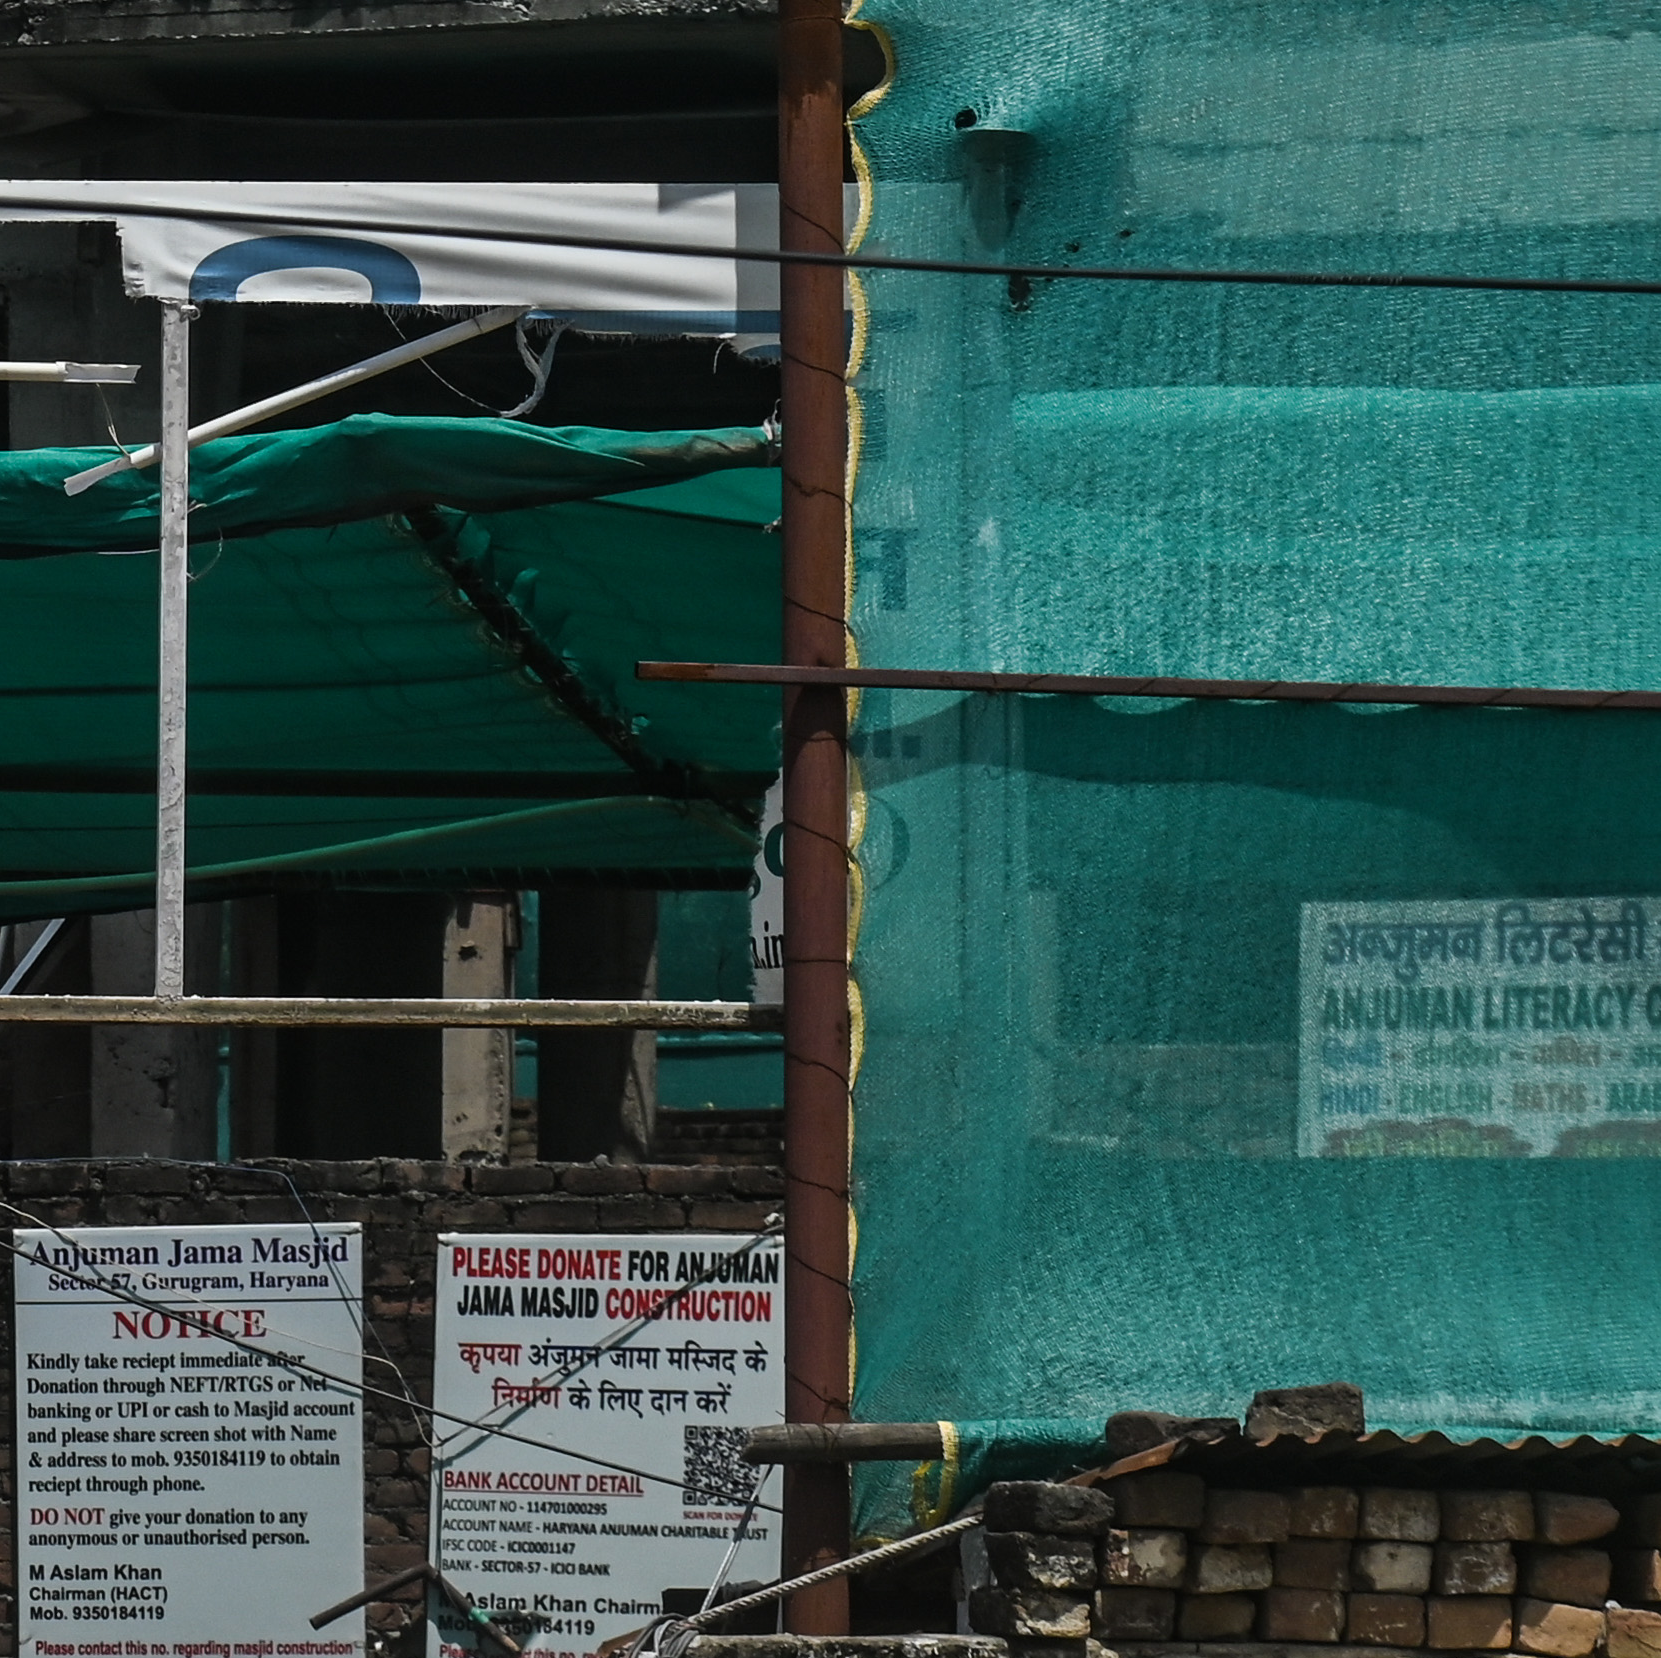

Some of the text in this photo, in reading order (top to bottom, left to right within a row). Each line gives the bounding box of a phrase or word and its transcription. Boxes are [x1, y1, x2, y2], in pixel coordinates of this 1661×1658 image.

[1323, 986, 1476, 1030] ANJUMAN
[1483, 984, 1636, 1030] LITERACY
[31, 1237, 348, 1271] Anjuman Jama Masjid
[452, 1247, 779, 1284] PLEASE DONATE FOR ANJUMAN
[48, 1271, 329, 1293] Sector 57, Gurugram, Haryana
[457, 1285, 772, 1322] JAMA MASJID CONSTRUCTION
[113, 1309, 267, 1339] NOTICE
[27, 1353, 79, 1373] Kindly
[85, 1353, 118, 1369] take
[123, 1355, 176, 1374] reciept
[180, 1353, 263, 1369] immediate
[458, 1338, 768, 1376] कृपया अंजुमन जामा मस्जिद के
[27, 1378, 99, 1395] Donation
[104, 1377, 165, 1397] through
[170, 1376, 273, 1394] NEFT/RTGS
[278, 1379, 297, 1392] or
[491, 1377, 733, 1418] निर्माण के लिए दान करें
[28, 1400, 355, 1422] banking or UPI or cash to Masjid account
[28, 1425, 337, 1447] and please share screen shot with Name
[29, 1450, 340, 1468] & address to mob. 9350184119 to obtain
[29, 1476, 205, 1496] reciept through phone.
[444, 1471, 644, 1495] BANK ACCOUNT DETAIL
[442, 1499, 496, 1512] ACCOUNT
[500, 1501, 517, 1513] NO
[30, 1508, 308, 1529] DO NOT give your donation to any
[442, 1519, 496, 1532] ACCOUNT
[499, 1521, 533, 1533] NAME
[543, 1522, 596, 1535] HARYANA
[600, 1524, 658, 1537] ANJUMAN
[661, 1526, 728, 1539] CHARITABLE
[29, 1530, 310, 1550] anonymous or unauthorised person.
[443, 1539, 465, 1551] IFSC
[467, 1540, 497, 1552] CODE
[30, 1564, 162, 1580] M Aslam Khan
[443, 1559, 611, 1575] BANK SECTOR-57 ICICI BANK
[30, 1587, 168, 1602] Chairman (HACT)
[534, 1594, 587, 1613] Khan
[30, 1606, 164, 1620] Mob. 9350184119
[36, 1641, 352, 1658] Please contact this no. regarding masjid construction
